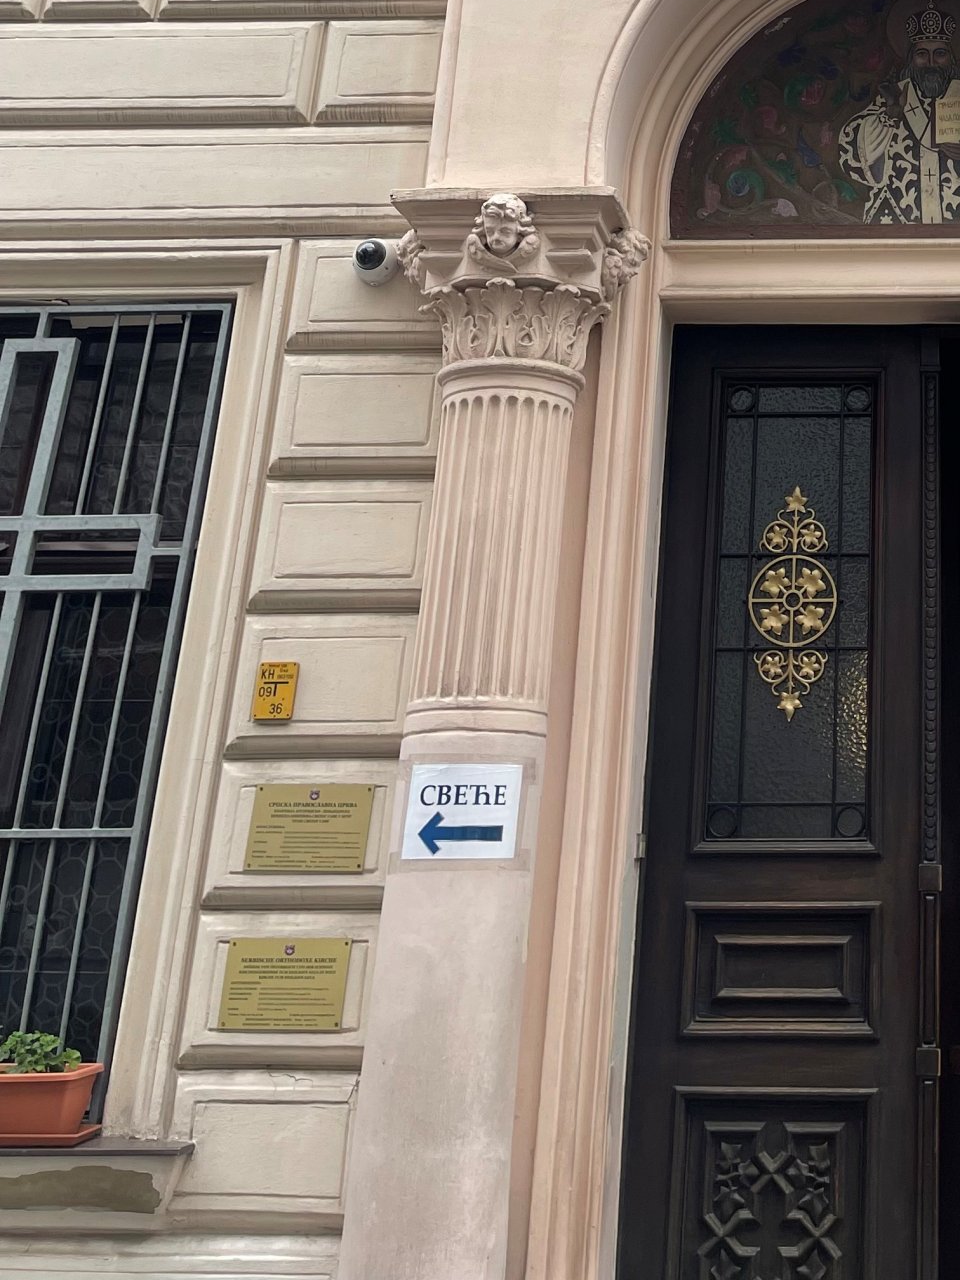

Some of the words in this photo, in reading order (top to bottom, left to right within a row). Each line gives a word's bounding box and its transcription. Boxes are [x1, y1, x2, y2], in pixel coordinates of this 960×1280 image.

[261, 668, 275, 680] KH
[258, 686, 272, 698] 09
[268, 703, 283, 715] 36
[419, 784, 507, 806] СВЕЋЕ
